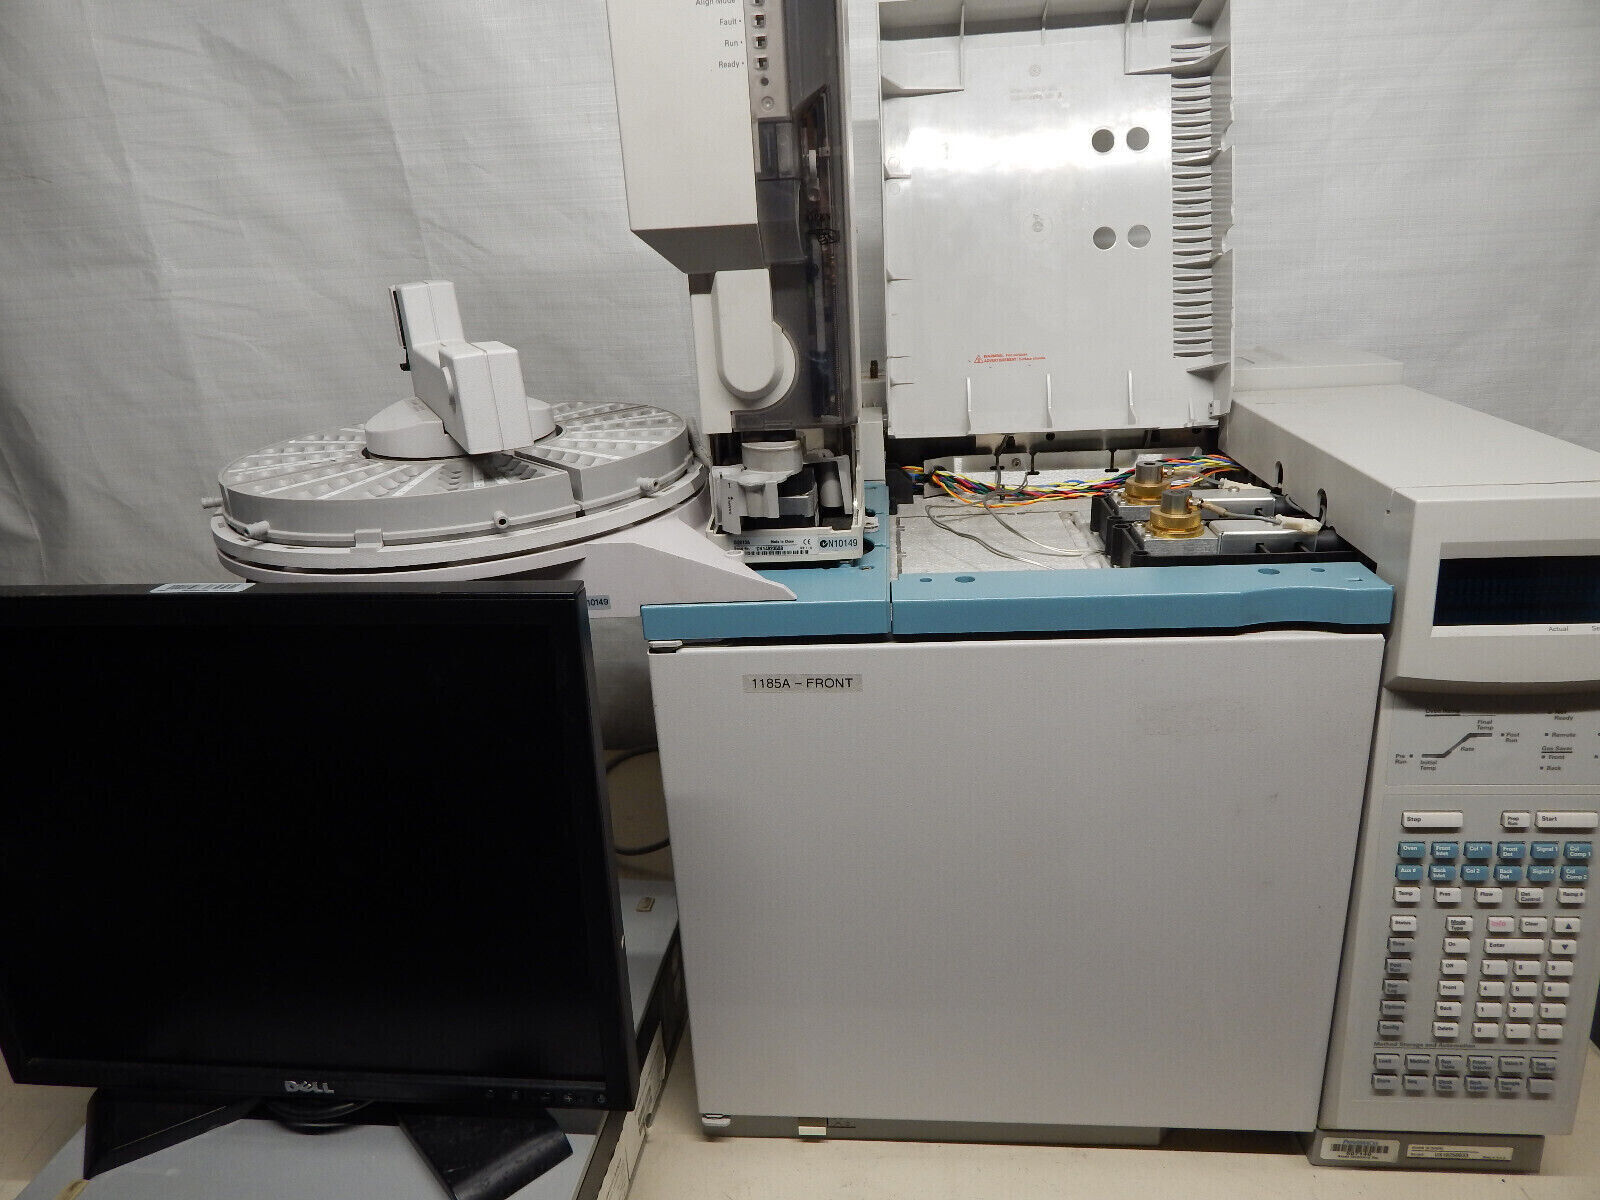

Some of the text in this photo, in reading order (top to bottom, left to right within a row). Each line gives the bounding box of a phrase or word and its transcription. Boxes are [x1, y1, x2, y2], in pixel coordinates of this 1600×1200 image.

[719, 61, 739, 69] Ready
[828, 539, 858, 548] N10149
[752, 678, 791, 689] 1185A
[806, 678, 853, 688] FRONT
[285, 1080, 335, 1094] DELL
